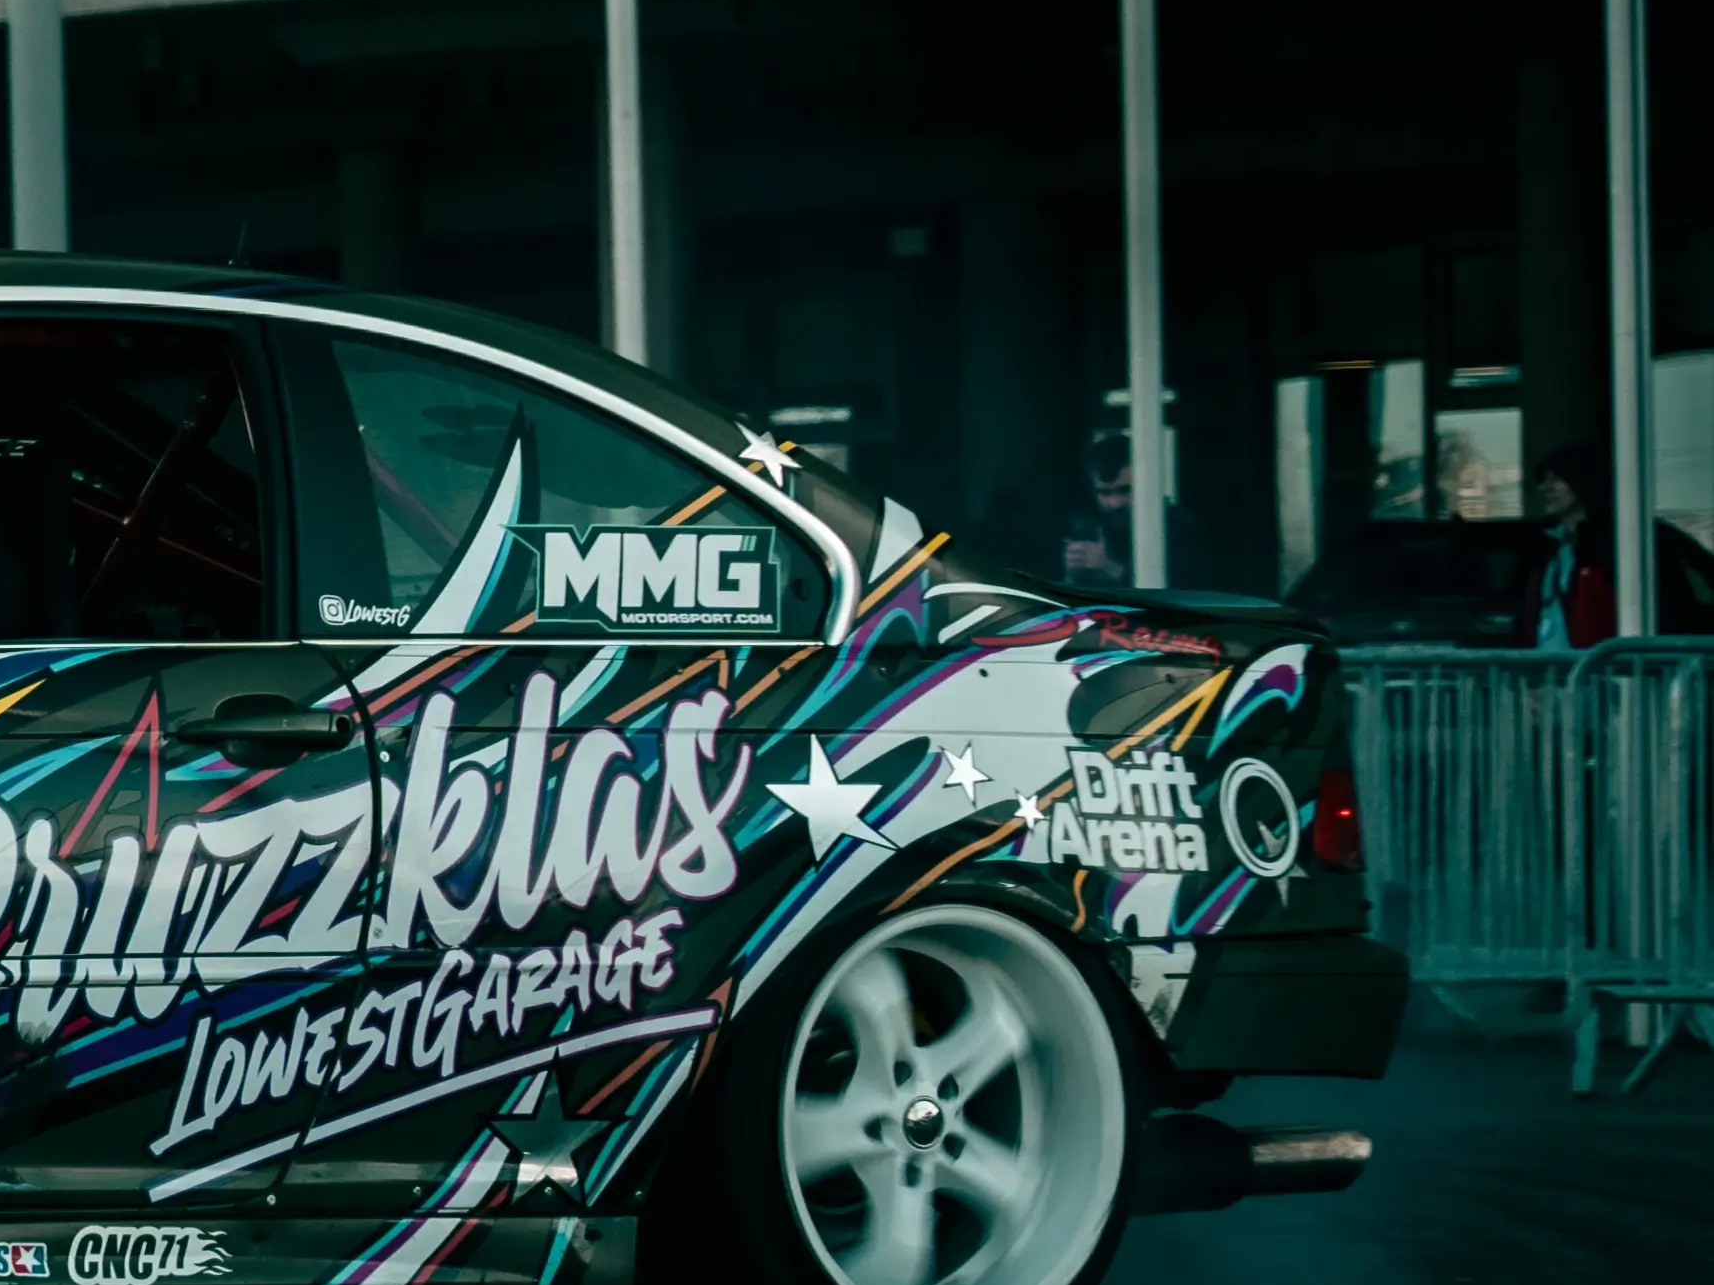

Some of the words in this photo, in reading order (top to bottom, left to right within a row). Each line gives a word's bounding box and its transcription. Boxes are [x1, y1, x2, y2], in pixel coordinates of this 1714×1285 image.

[544, 532, 761, 622] MMG
[621, 612, 774, 625] MOTORSPORT.COM
[1070, 747, 1203, 819] Drift
[1050, 800, 1210, 873] Arena
[75, 1231, 191, 1281] CNC71
